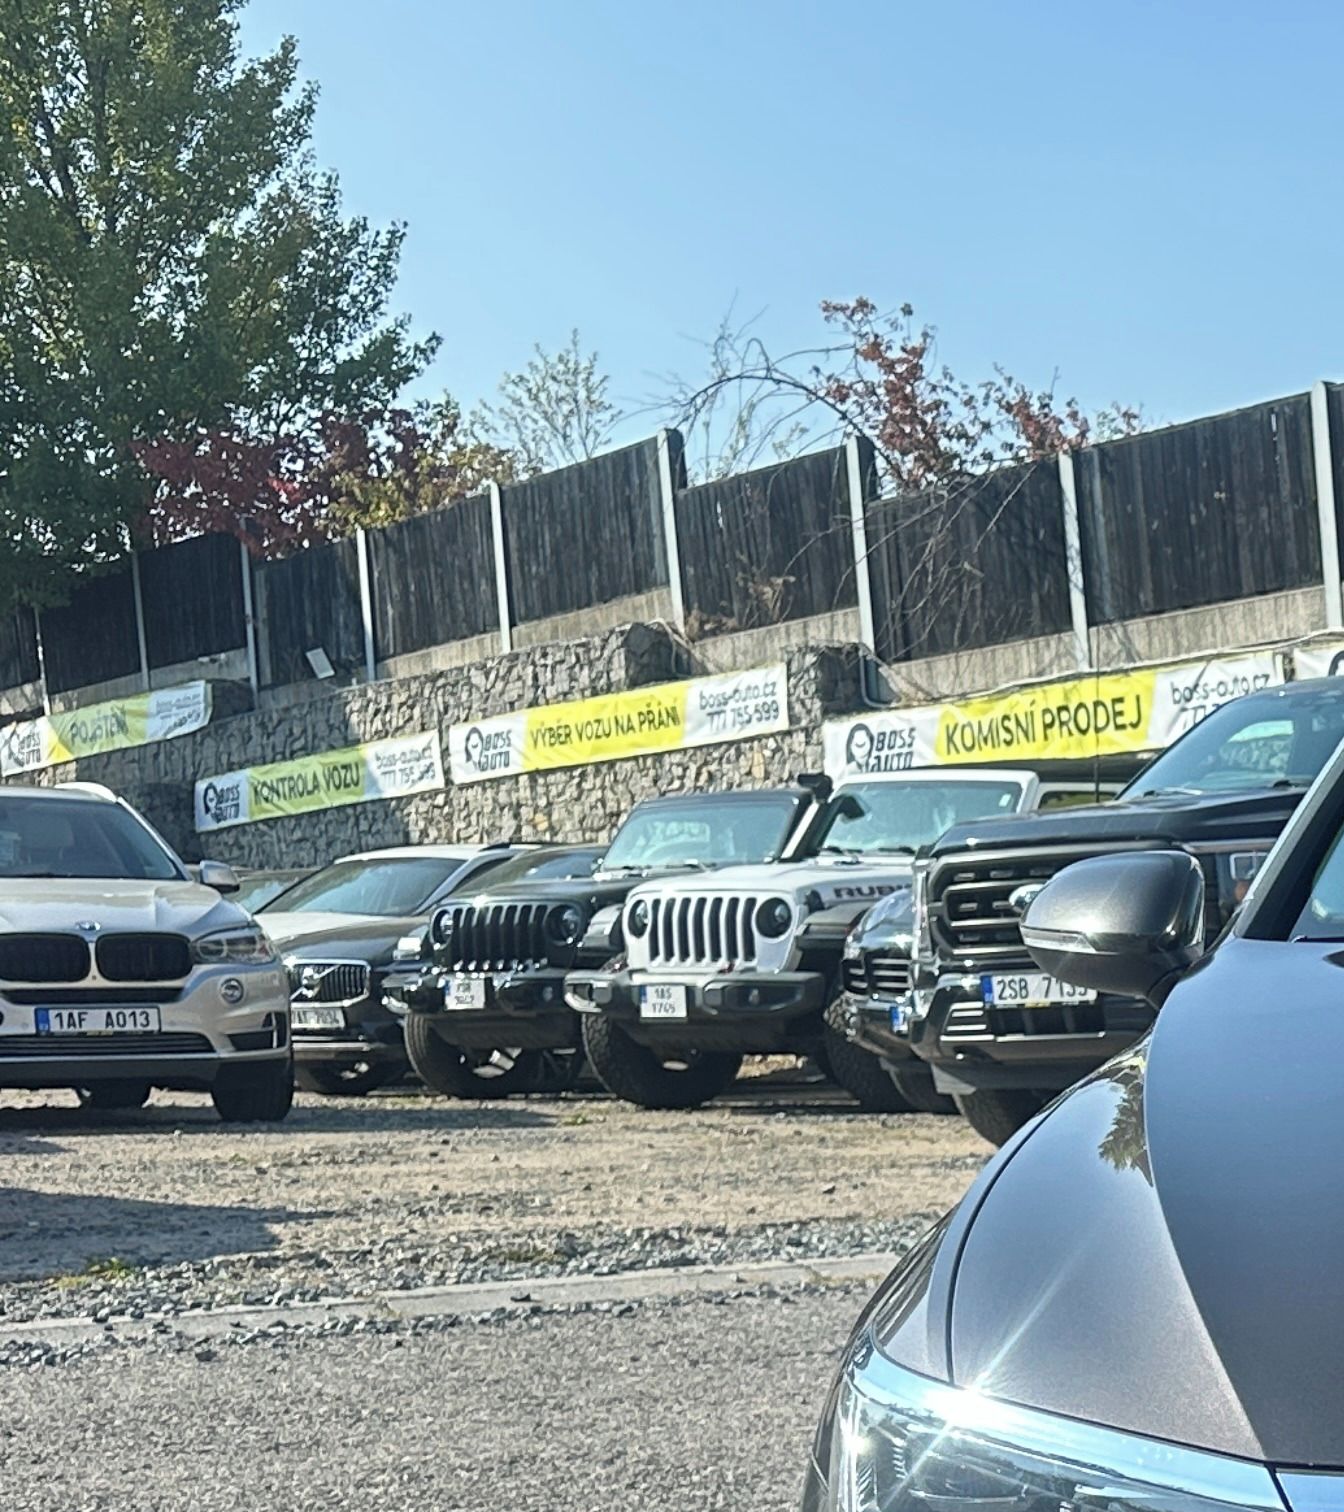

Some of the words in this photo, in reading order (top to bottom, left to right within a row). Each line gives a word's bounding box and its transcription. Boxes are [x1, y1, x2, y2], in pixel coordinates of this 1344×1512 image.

[575, 717, 612, 742] VOZU
[614, 713, 635, 737] NA
[945, 699, 1036, 755] KOMISNÍ
[1041, 694, 1142, 742] PRODEJ
[874, 726, 917, 752] BOSS
[252, 770, 320, 806] KONTROLA
[321, 761, 360, 792] VOZU
[997, 977, 1029, 1001] 2SB
[54, 1011, 88, 1030] 1AF
[105, 1010, 150, 1029] A013
